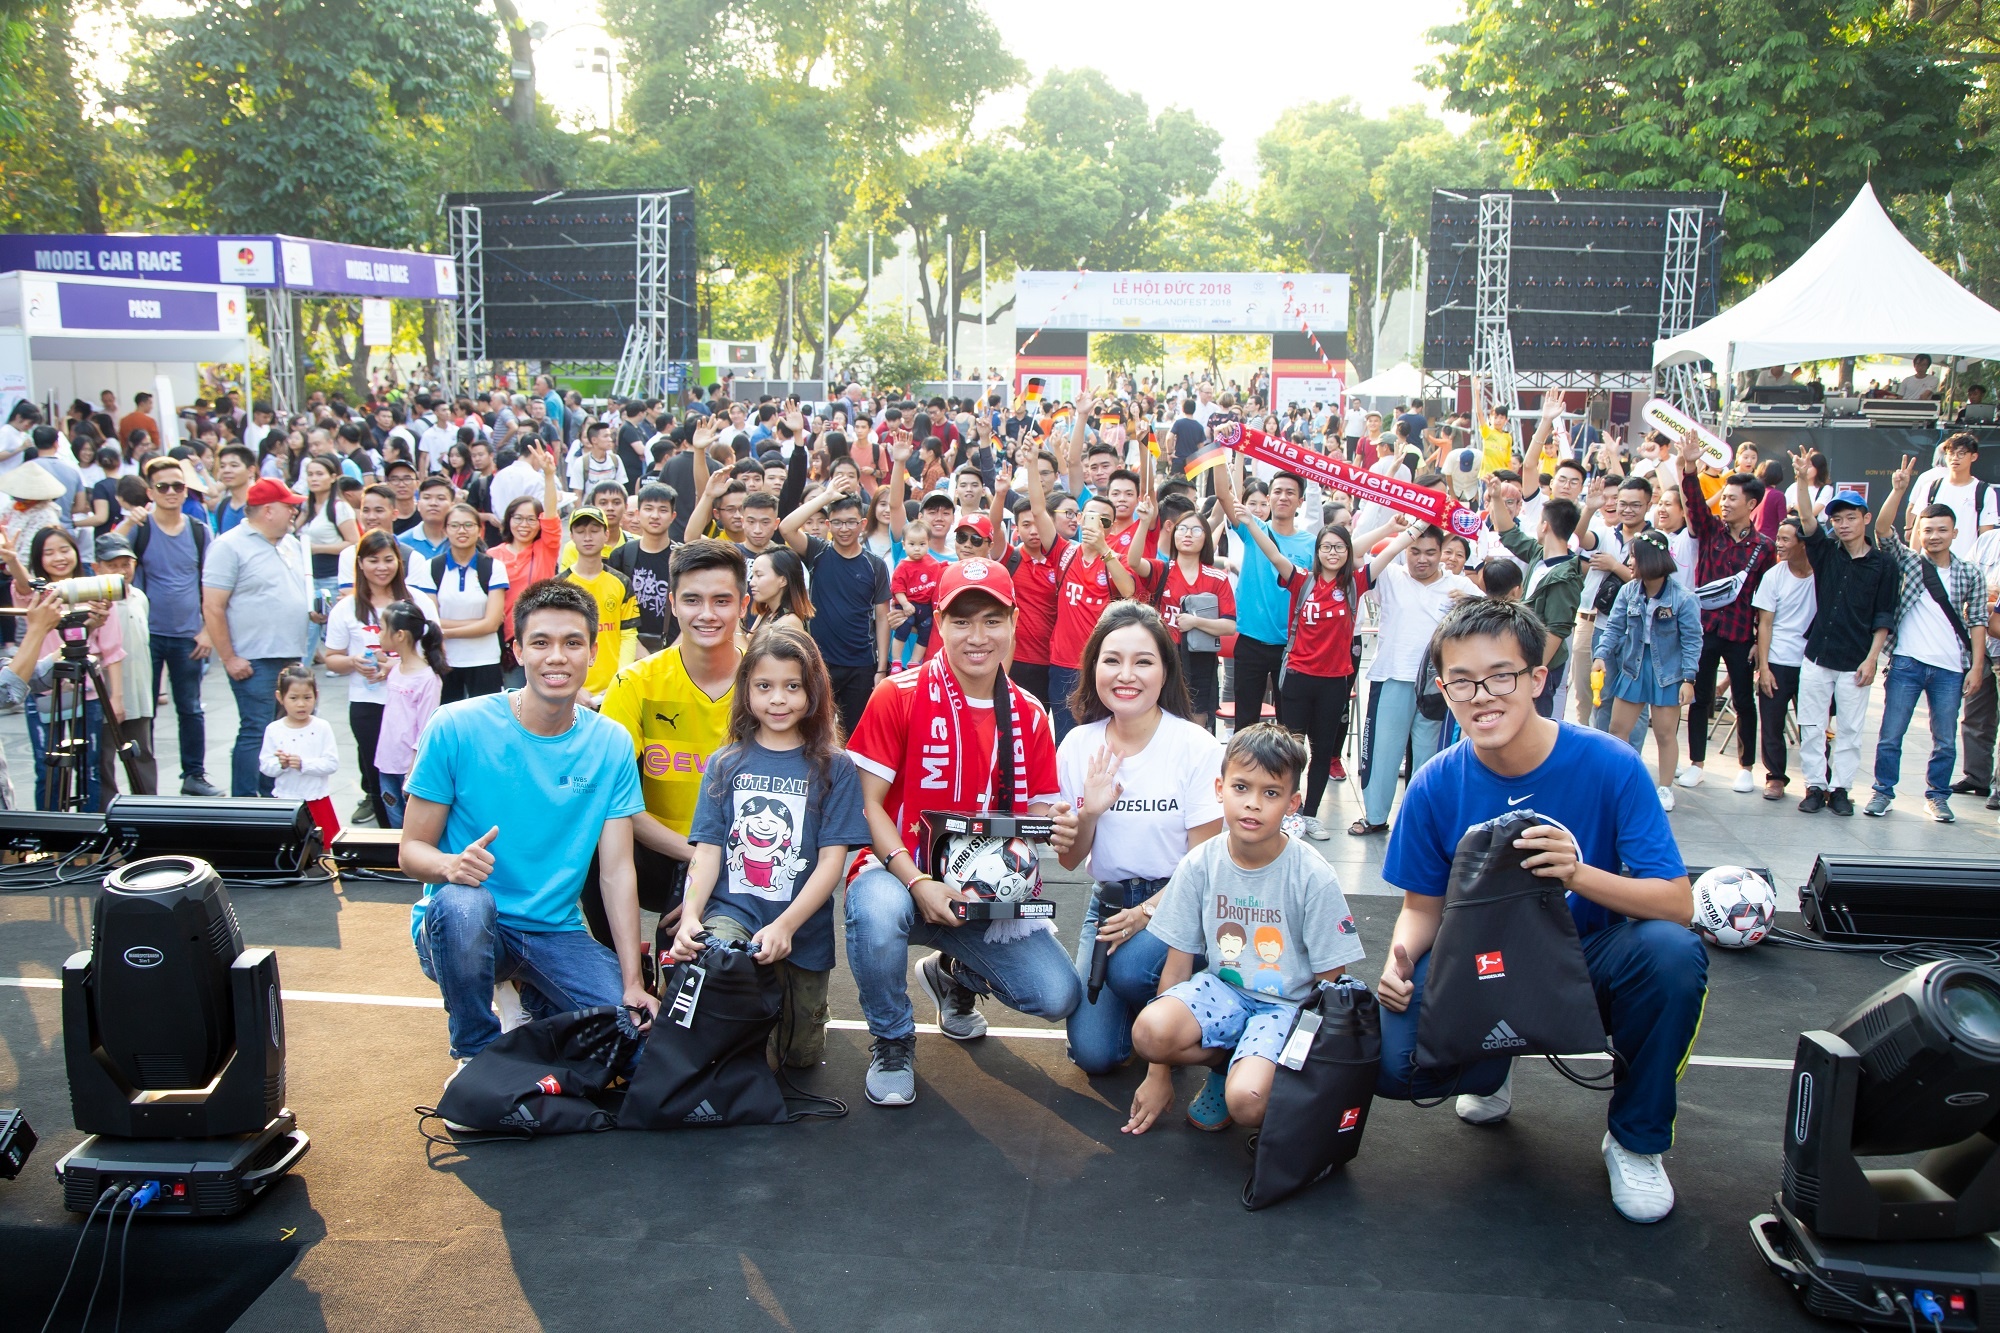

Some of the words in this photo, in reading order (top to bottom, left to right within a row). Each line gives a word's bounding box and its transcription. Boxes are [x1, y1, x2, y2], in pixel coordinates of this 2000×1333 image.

[34, 250, 95, 271] MODEL
[98, 251, 134, 271] CAR
[137, 251, 183, 272] RACE
[345, 259, 374, 281] MODEL
[374, 263, 390, 283] CAR
[390, 264, 410, 284] RACE
[1113, 278, 1128, 294] LỄ
[1133, 279, 1159, 297] HỘI
[1164, 280, 1195, 295] ĐỨC
[1199, 283, 1232, 295] 2018
[128, 299, 162, 319] PASCH
[1112, 298, 1207, 307] DEUTSCHLANDFEST
[1210, 299, 1232, 307] 2018
[1262, 434, 1299, 460] Mia
[1303, 453, 1342, 476] san
[1348, 468, 1436, 508] Vietnam
[1295, 467, 1350, 493] OFFIZIELLER
[1350, 488, 1392, 507] FANCLUB
[920, 716, 949, 789] Mia
[733, 773, 770, 791] CÜTE
[772, 777, 808, 797] BALI
[1020, 904, 1054, 913] DERBYSTAR
[1216, 894, 1282, 926] BROTHERS
[1235, 897, 1247, 907] THE
[1248, 895, 1265, 908] BALI
[1482, 1037, 1528, 1050] adidas
[499, 1118, 541, 1128] adidas
[683, 1113, 723, 1123] adidas
